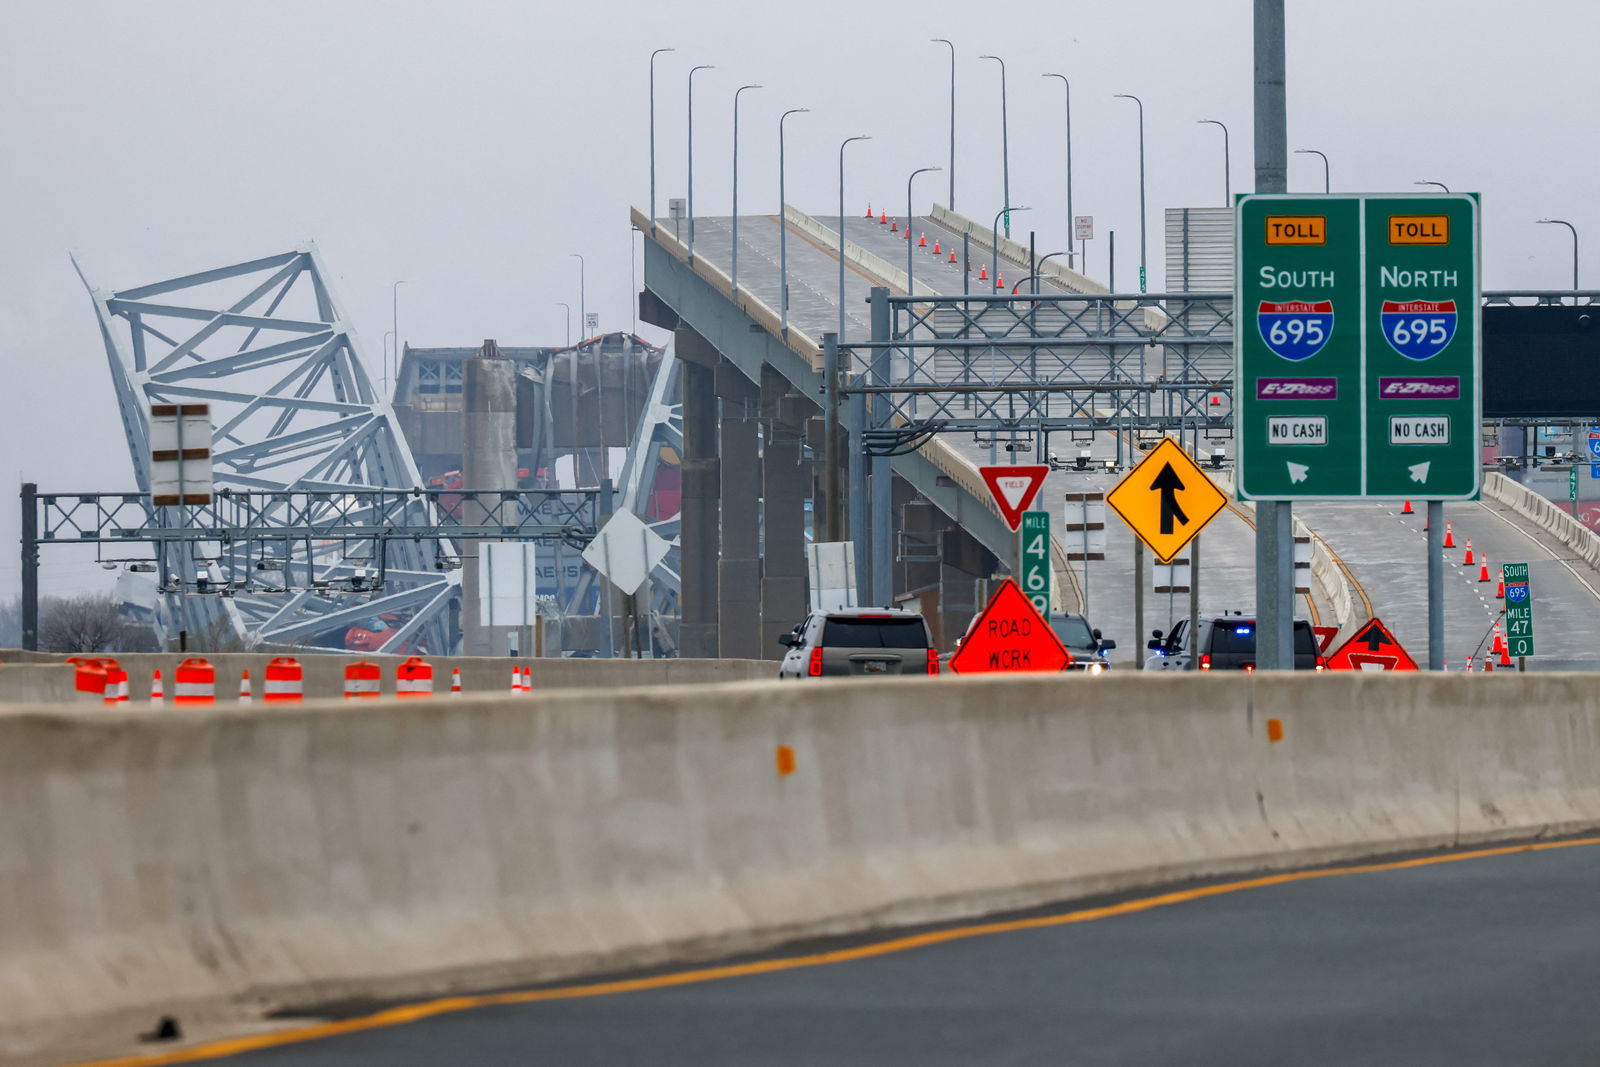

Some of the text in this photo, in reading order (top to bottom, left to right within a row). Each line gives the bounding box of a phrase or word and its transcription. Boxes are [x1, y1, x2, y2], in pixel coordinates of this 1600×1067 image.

[1272, 223, 1319, 238] TOLL
[1395, 223, 1442, 237] TOLL
[1259, 265, 1335, 288] SOUTH
[1380, 265, 1457, 288] NORTH
[1275, 303, 1316, 312] INTERSTATE
[1398, 303, 1440, 312] INTERSTATE
[1269, 318, 1324, 345] 695
[1393, 318, 1447, 345] 695
[1272, 423, 1322, 438] NO CASH
[1394, 422, 1444, 438] NO CASH
[1026, 517, 1046, 529] MILE
[1504, 565, 1528, 577] SOUTH
[1509, 587, 1526, 598] 695
[1507, 607, 1530, 619] MILE
[988, 618, 1032, 638] ROAD
[1510, 620, 1528, 634] 47
[989, 650, 1032, 669] WORK
